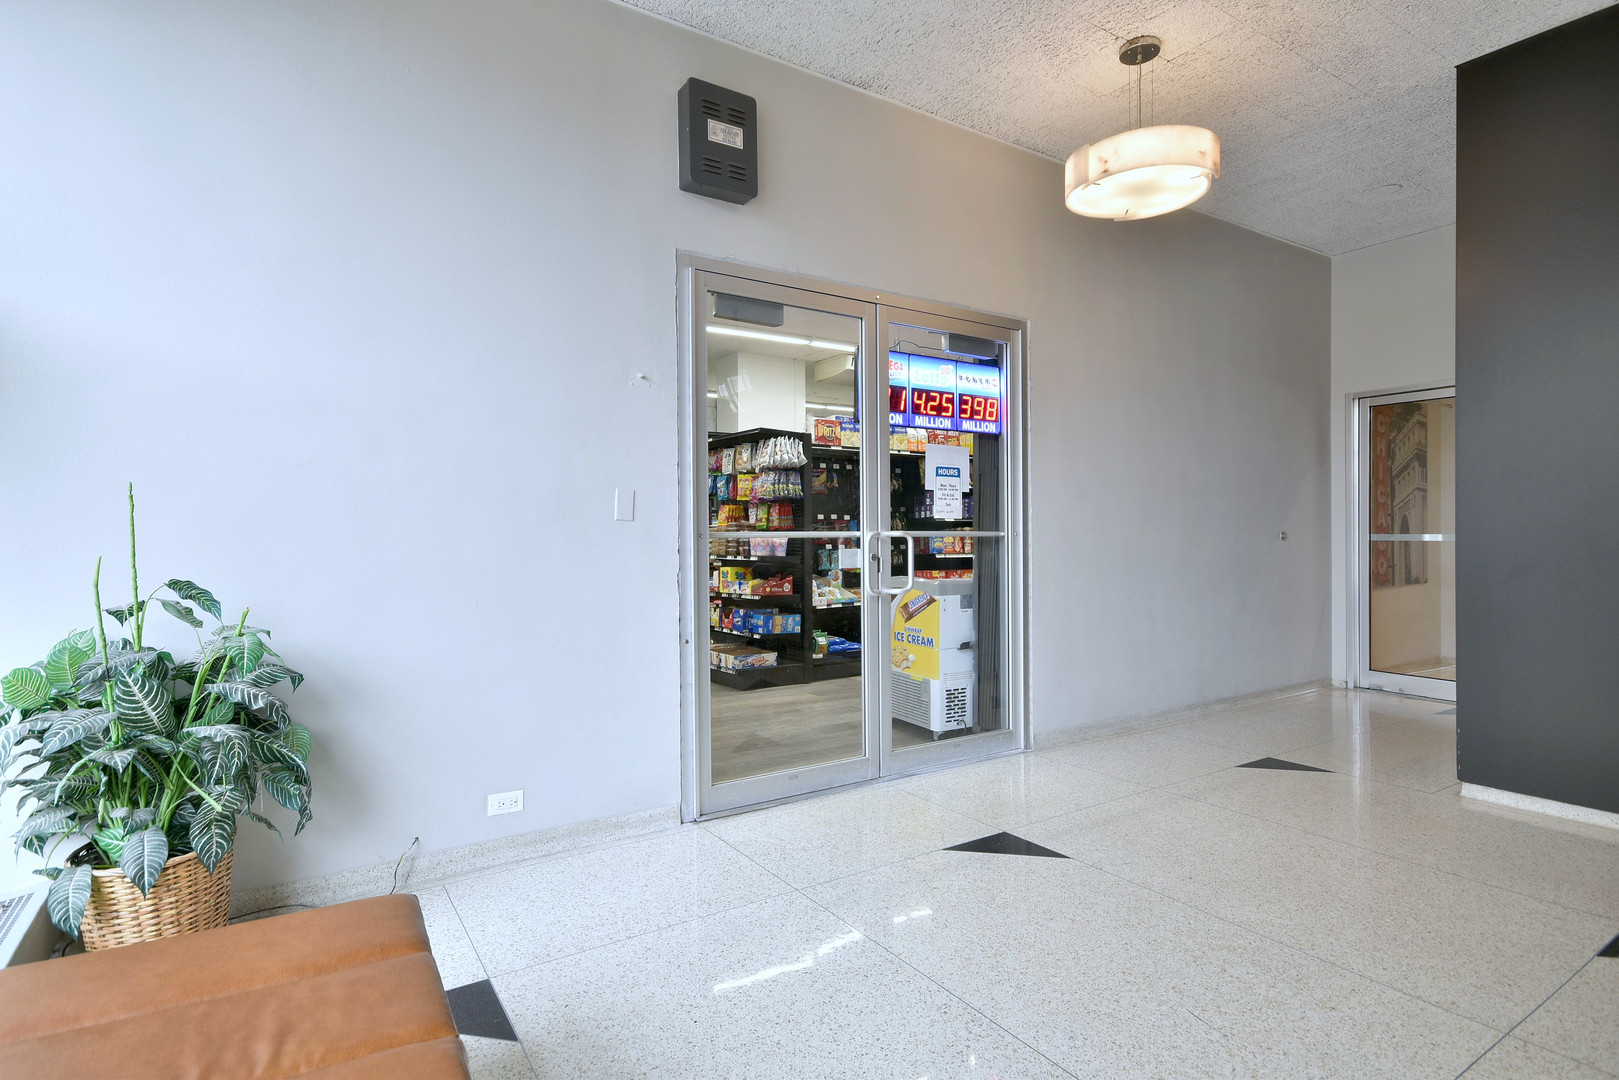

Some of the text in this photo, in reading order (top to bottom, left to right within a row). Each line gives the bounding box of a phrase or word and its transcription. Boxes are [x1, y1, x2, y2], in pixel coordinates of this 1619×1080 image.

[889, 360, 904, 371] EGA
[913, 391, 953, 417] 4.25
[960, 395, 998, 421] 398
[915, 415, 951, 429] MILLION
[962, 420, 996, 433] MILLION
[823, 426, 836, 437] RITZ
[938, 468, 958, 476] HOURS
[894, 631, 934, 648] ICE CREAM
